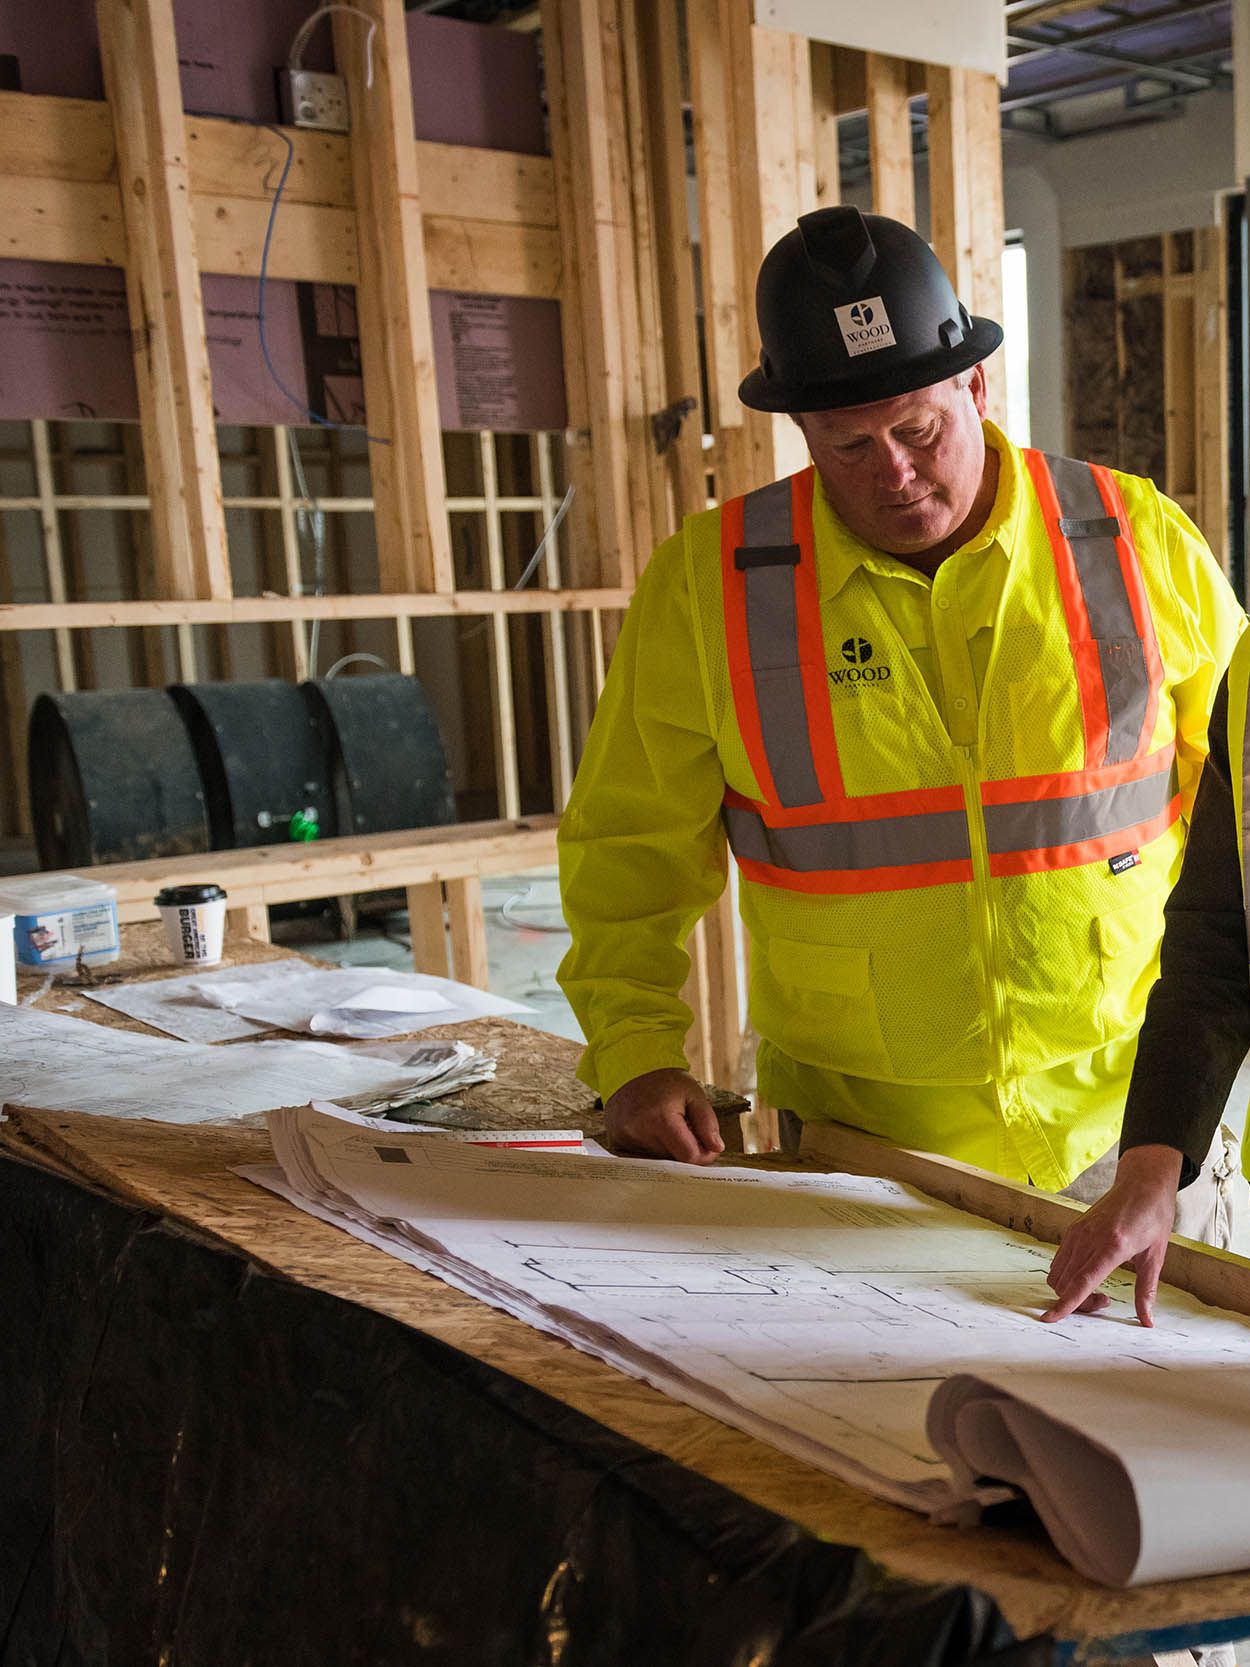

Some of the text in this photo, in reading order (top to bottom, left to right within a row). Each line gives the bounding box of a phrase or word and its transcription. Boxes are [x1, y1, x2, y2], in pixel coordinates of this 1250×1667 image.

[847, 324, 890, 343] WOOD
[828, 666, 891, 685] WOOD
[179, 908, 195, 960] BURGER
